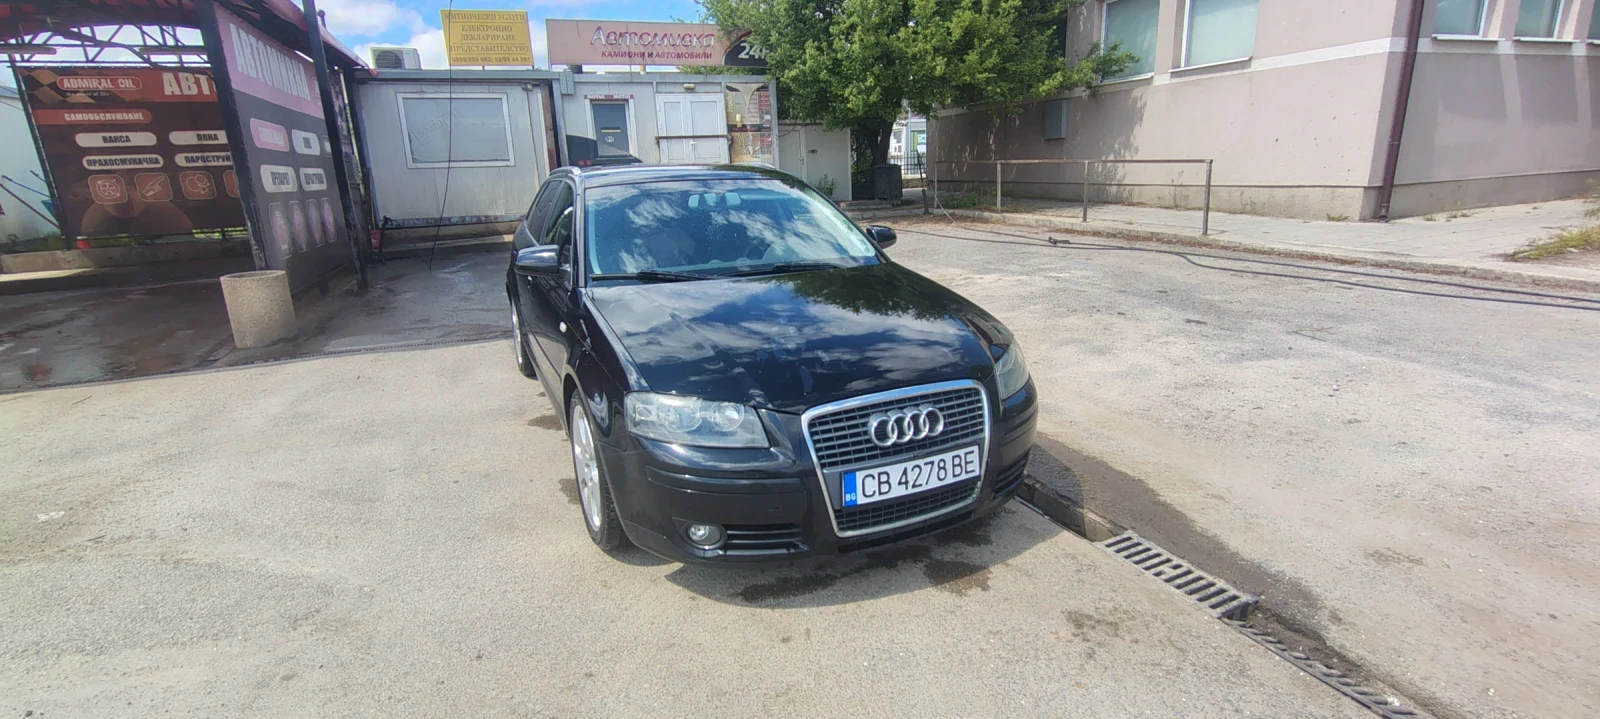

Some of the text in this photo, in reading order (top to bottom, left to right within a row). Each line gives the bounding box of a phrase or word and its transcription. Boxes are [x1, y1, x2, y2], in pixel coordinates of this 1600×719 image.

[498, 12, 525, 21] УСЛУГИ
[590, 26, 715, 47] Автомивка
[601, 51, 713, 59] КАМИОНИ И АВТОМОБИЛИ
[229, 23, 311, 101] АВТОМИВКА
[63, 77, 136, 89] ADMIRAL OIL
[162, 72, 217, 96] АВТ
[64, 112, 144, 121] САМООБСЛУЖВАНЕ
[102, 135, 131, 144] ВАКСА
[196, 133, 220, 142] ПЯНА
[86, 156, 160, 167] ПРАХОСМУКАЧКА
[184, 153, 232, 163] ПАРОСТРУЙ
[861, 450, 976, 498] CB 4278 BE
[845, 493, 856, 501] BG
